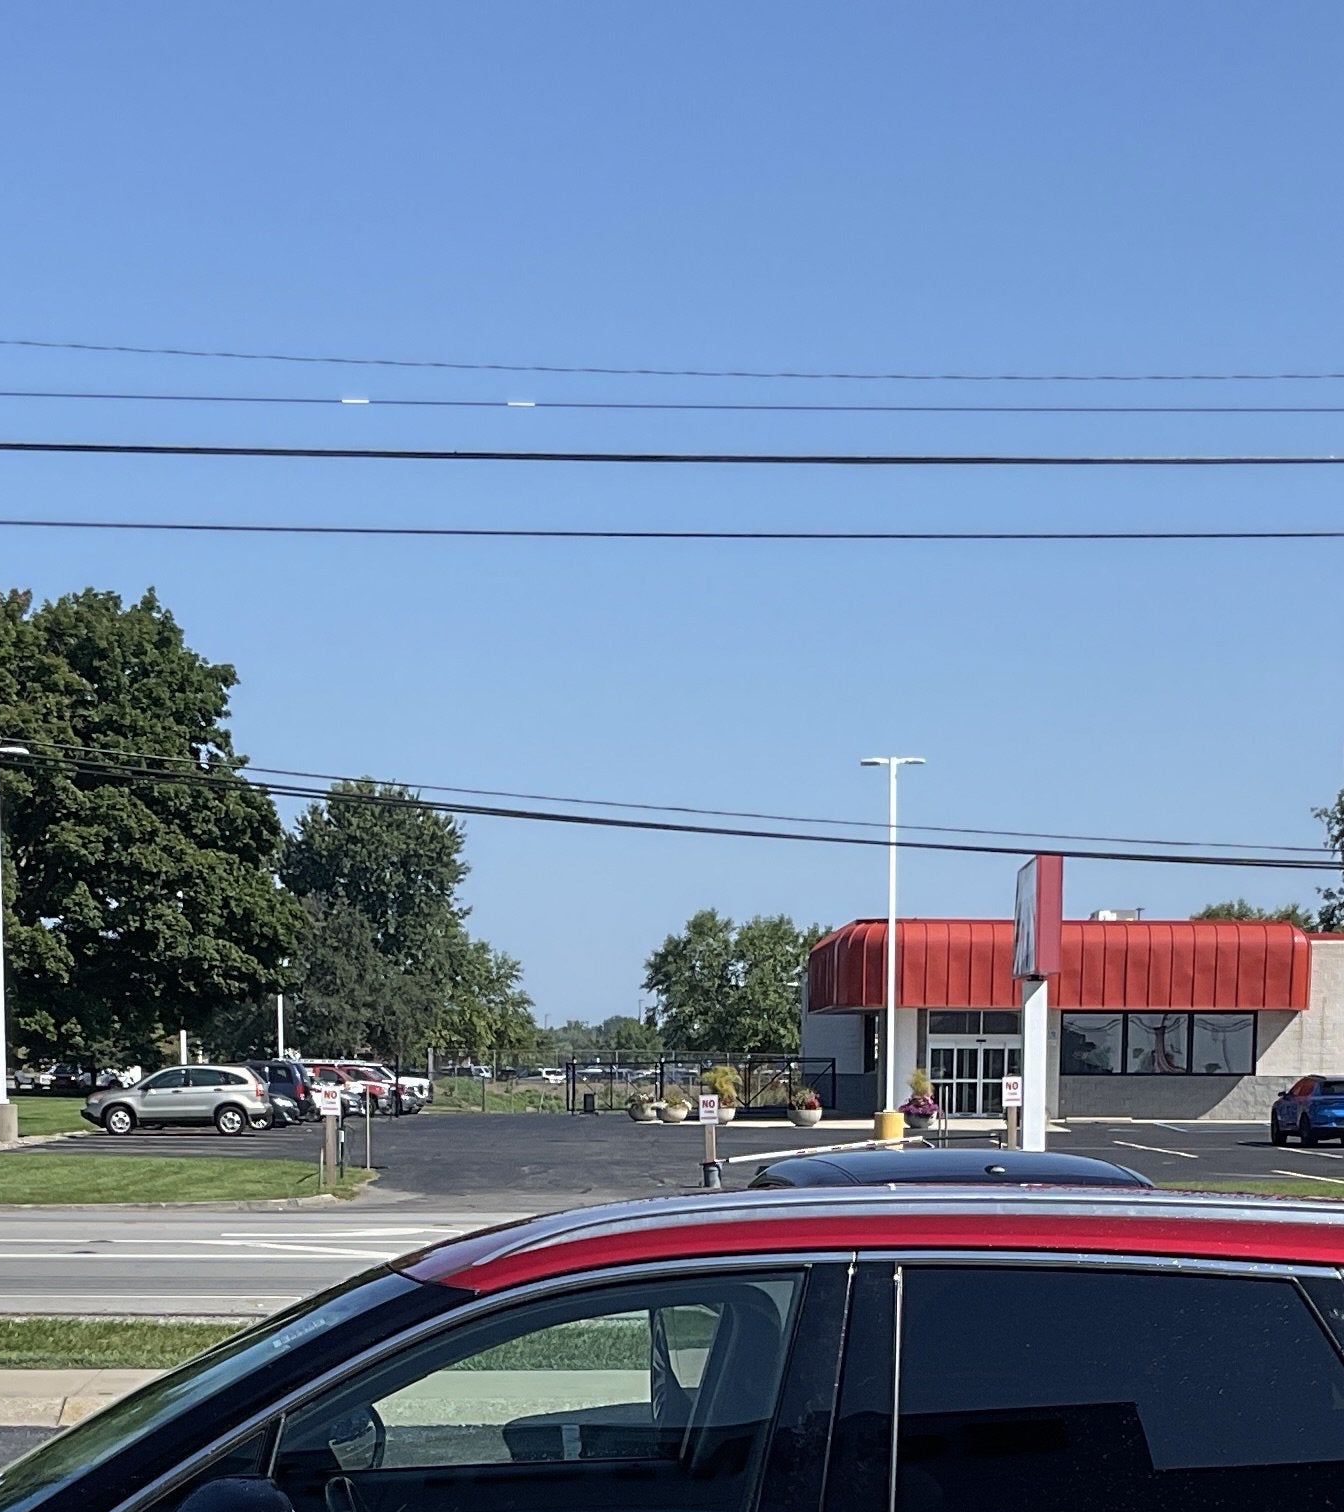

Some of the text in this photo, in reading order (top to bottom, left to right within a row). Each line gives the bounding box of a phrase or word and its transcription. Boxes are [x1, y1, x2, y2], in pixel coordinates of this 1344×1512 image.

[1006, 1081, 1019, 1091] NO
[323, 1090, 337, 1099] NO
[702, 1099, 715, 1109] NO
